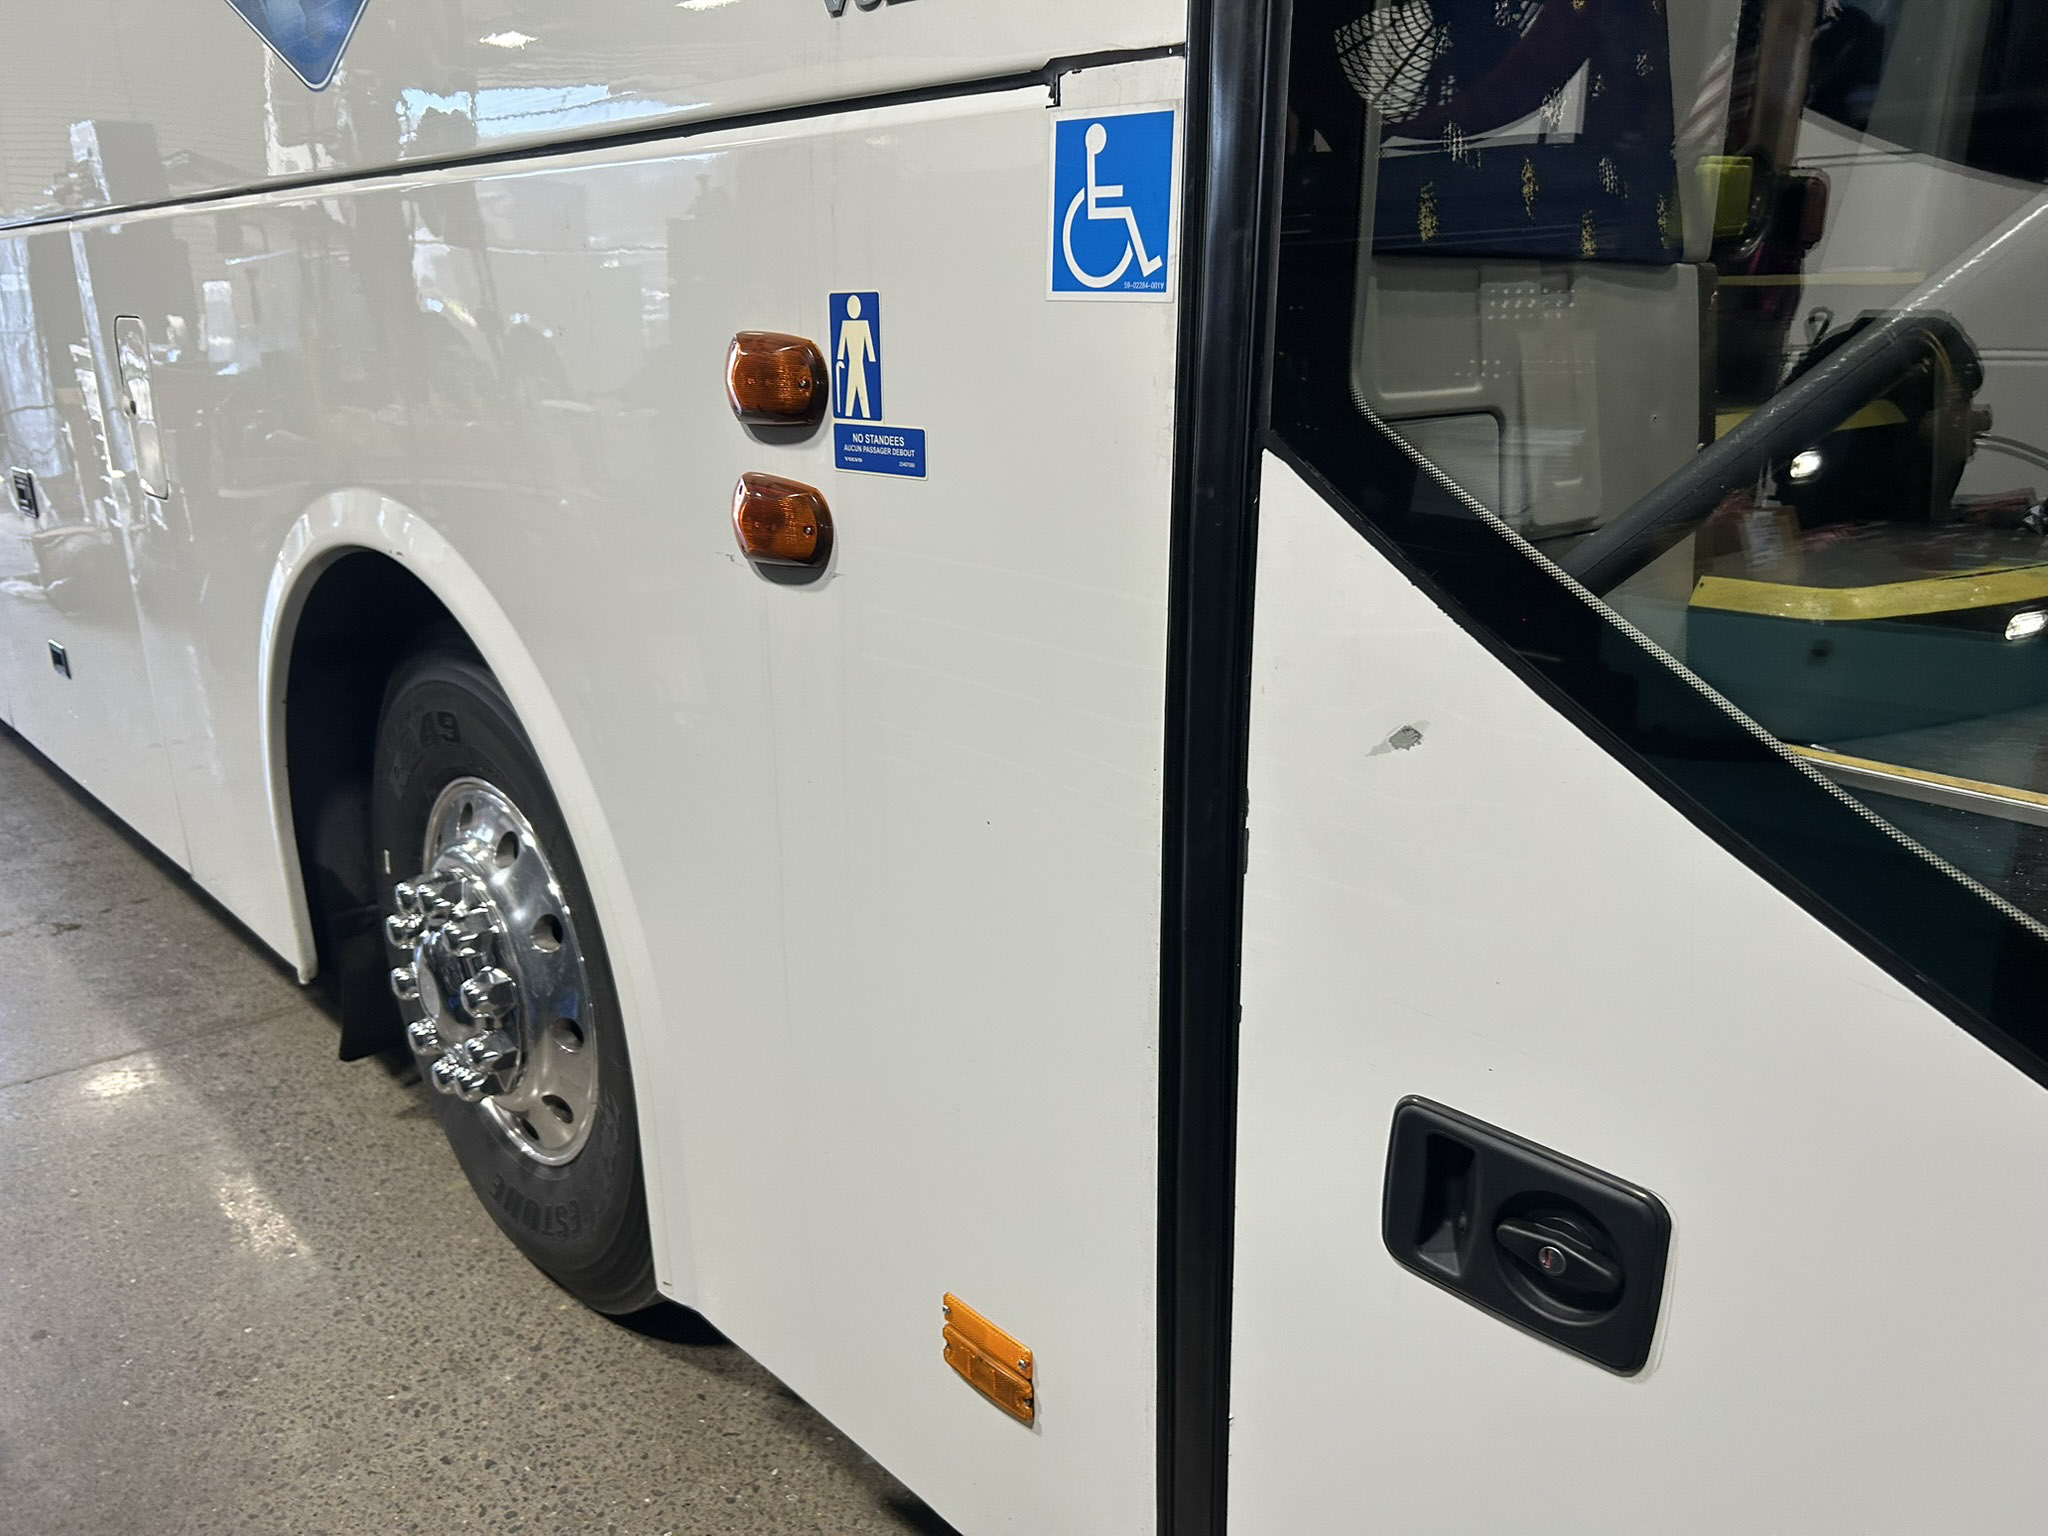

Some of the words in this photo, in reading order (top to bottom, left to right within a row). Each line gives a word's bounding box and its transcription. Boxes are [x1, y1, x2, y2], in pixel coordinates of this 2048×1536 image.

[852, 432, 864, 443] NO
[865, 433, 905, 447] STANDEES
[843, 444, 862, 453] AUCUN
[863, 445, 892, 455] PASSAGER
[892, 448, 915, 457] DEBOUT
